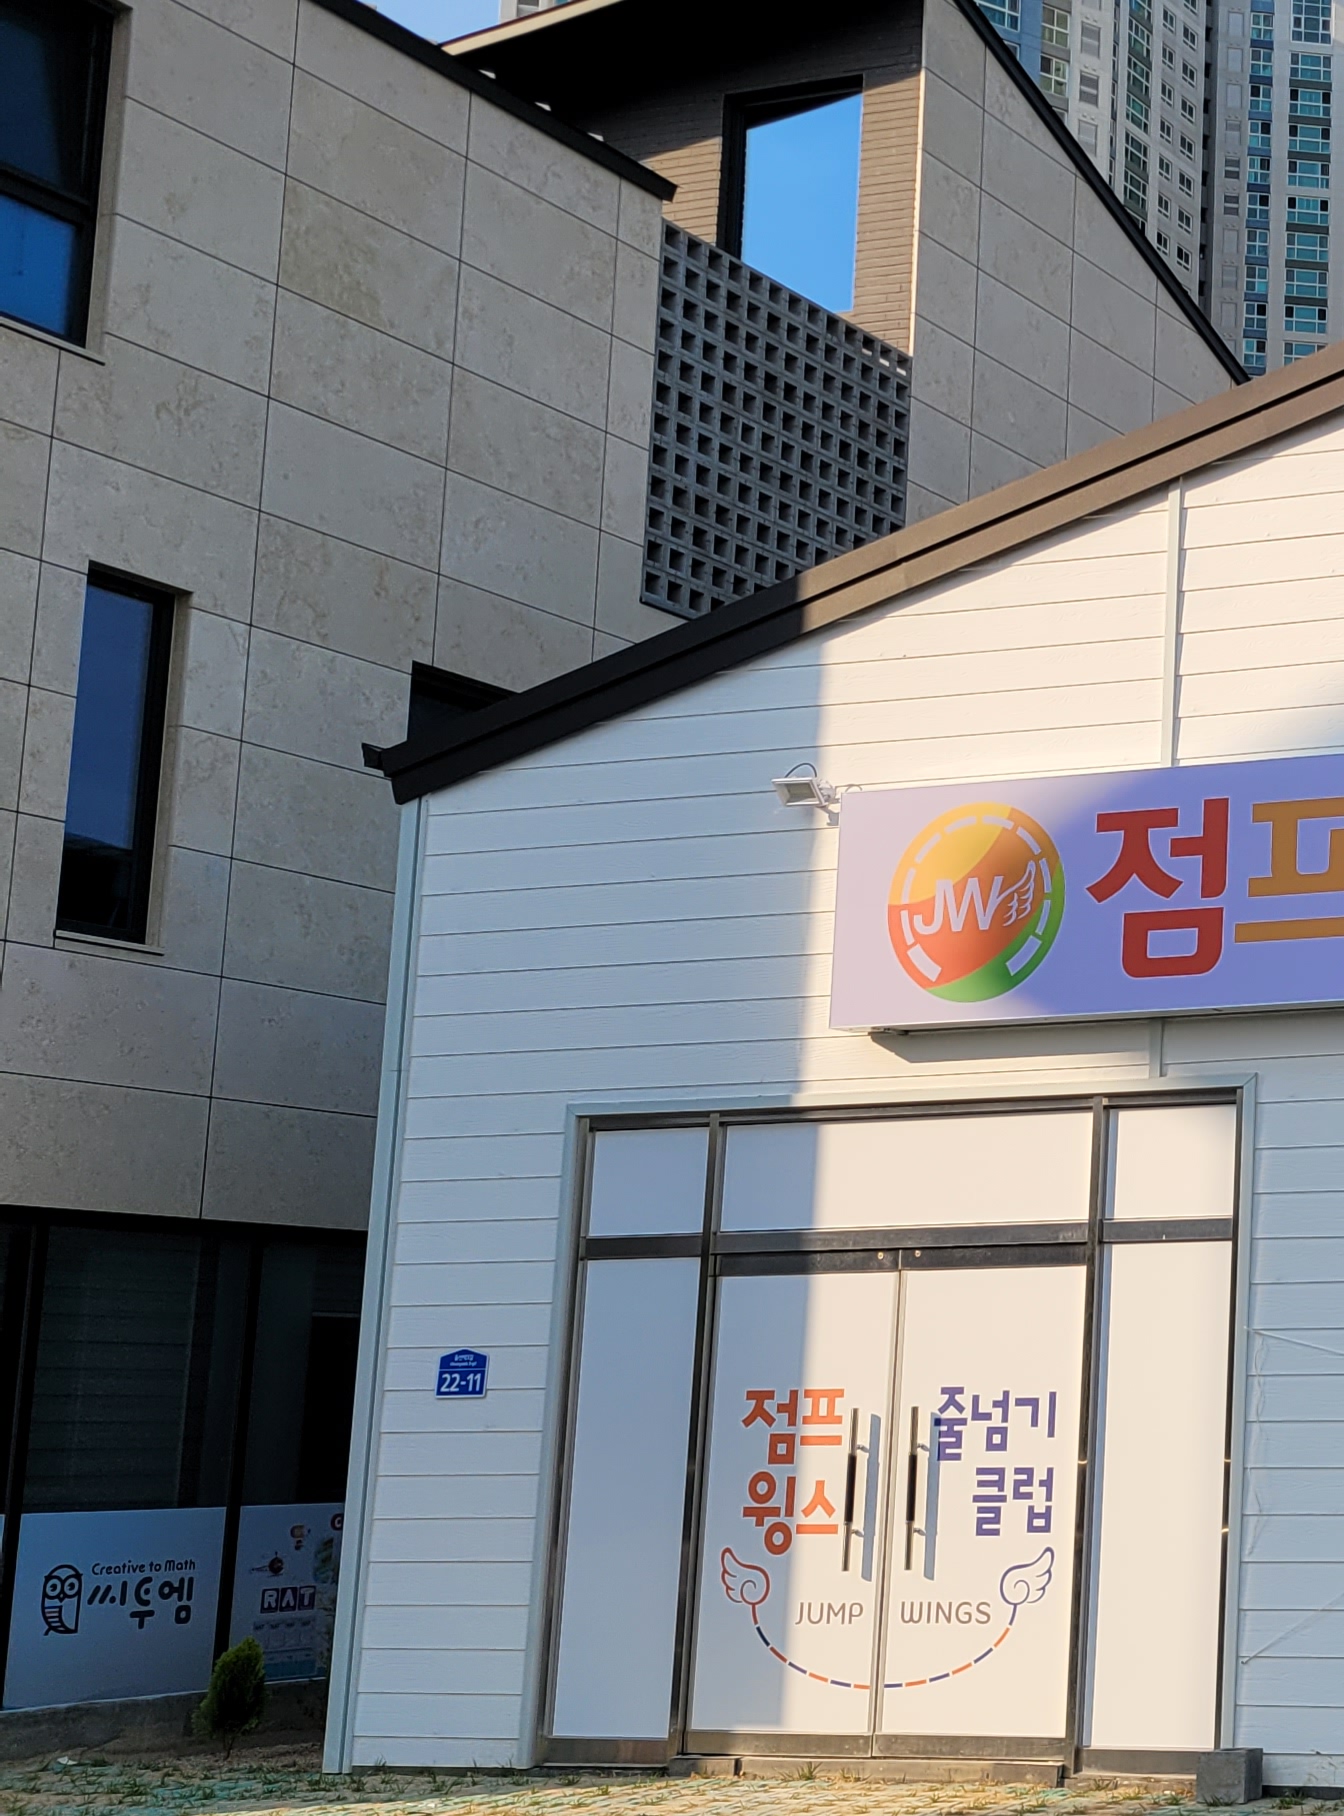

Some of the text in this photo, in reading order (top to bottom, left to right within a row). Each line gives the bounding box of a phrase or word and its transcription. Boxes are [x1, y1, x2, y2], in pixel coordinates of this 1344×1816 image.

[440, 1373, 482, 1392] 22-11
[741, 1388, 845, 1465] 점프
[934, 1386, 1057, 1462] 줄넘기
[742, 1471, 839, 1556] 윙스
[972, 1467, 1054, 1536] 클럽
[91, 1558, 196, 1576] Creative to Math
[795, 1601, 992, 1626] JUMP WINGS
